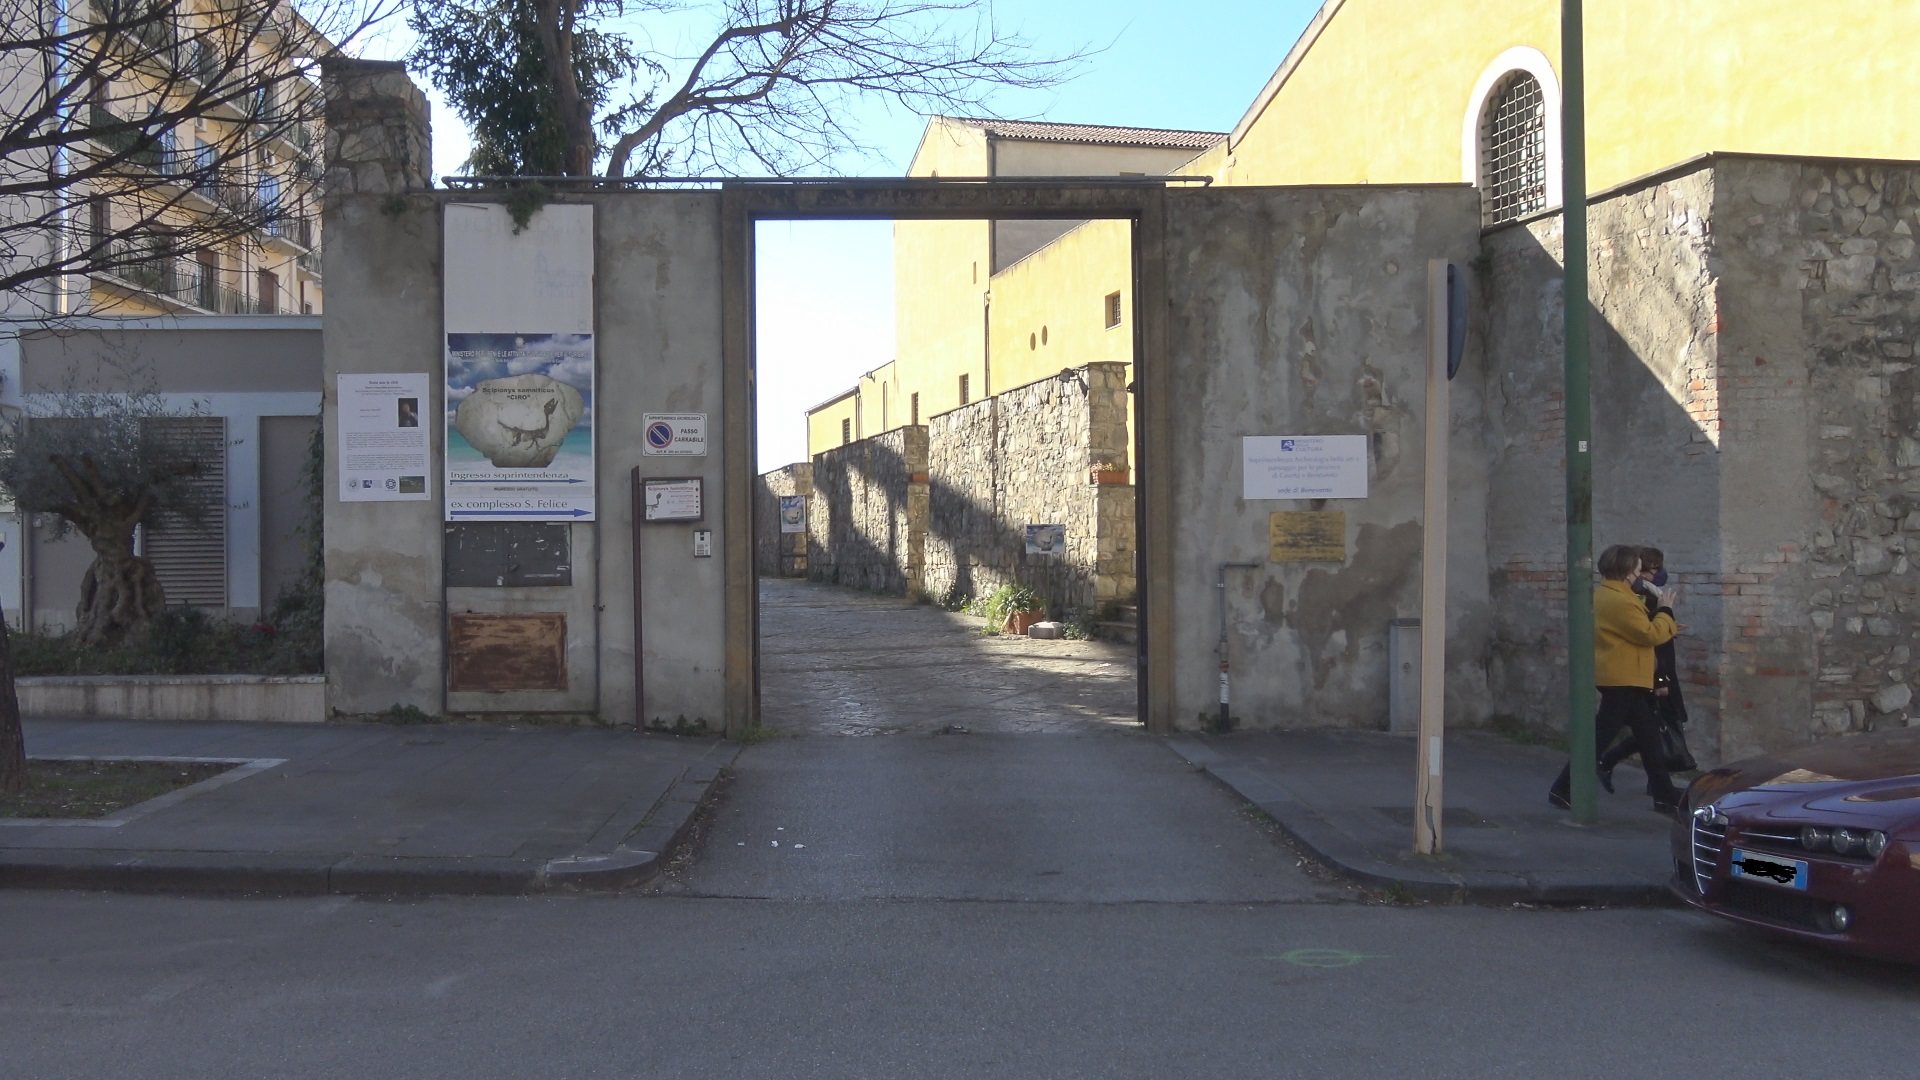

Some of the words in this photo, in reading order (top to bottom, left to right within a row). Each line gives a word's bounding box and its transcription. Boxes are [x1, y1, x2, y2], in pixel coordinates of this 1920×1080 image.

[451, 350, 474, 358] MINISTERO
[1248, 456, 1293, 465] Soprintendenza
[450, 472, 491, 480] Ingresso
[493, 471, 569, 480] soprintendenza
[466, 500, 522, 510] complesso
[525, 500, 534, 508] S.
[537, 500, 568, 508] Felice
